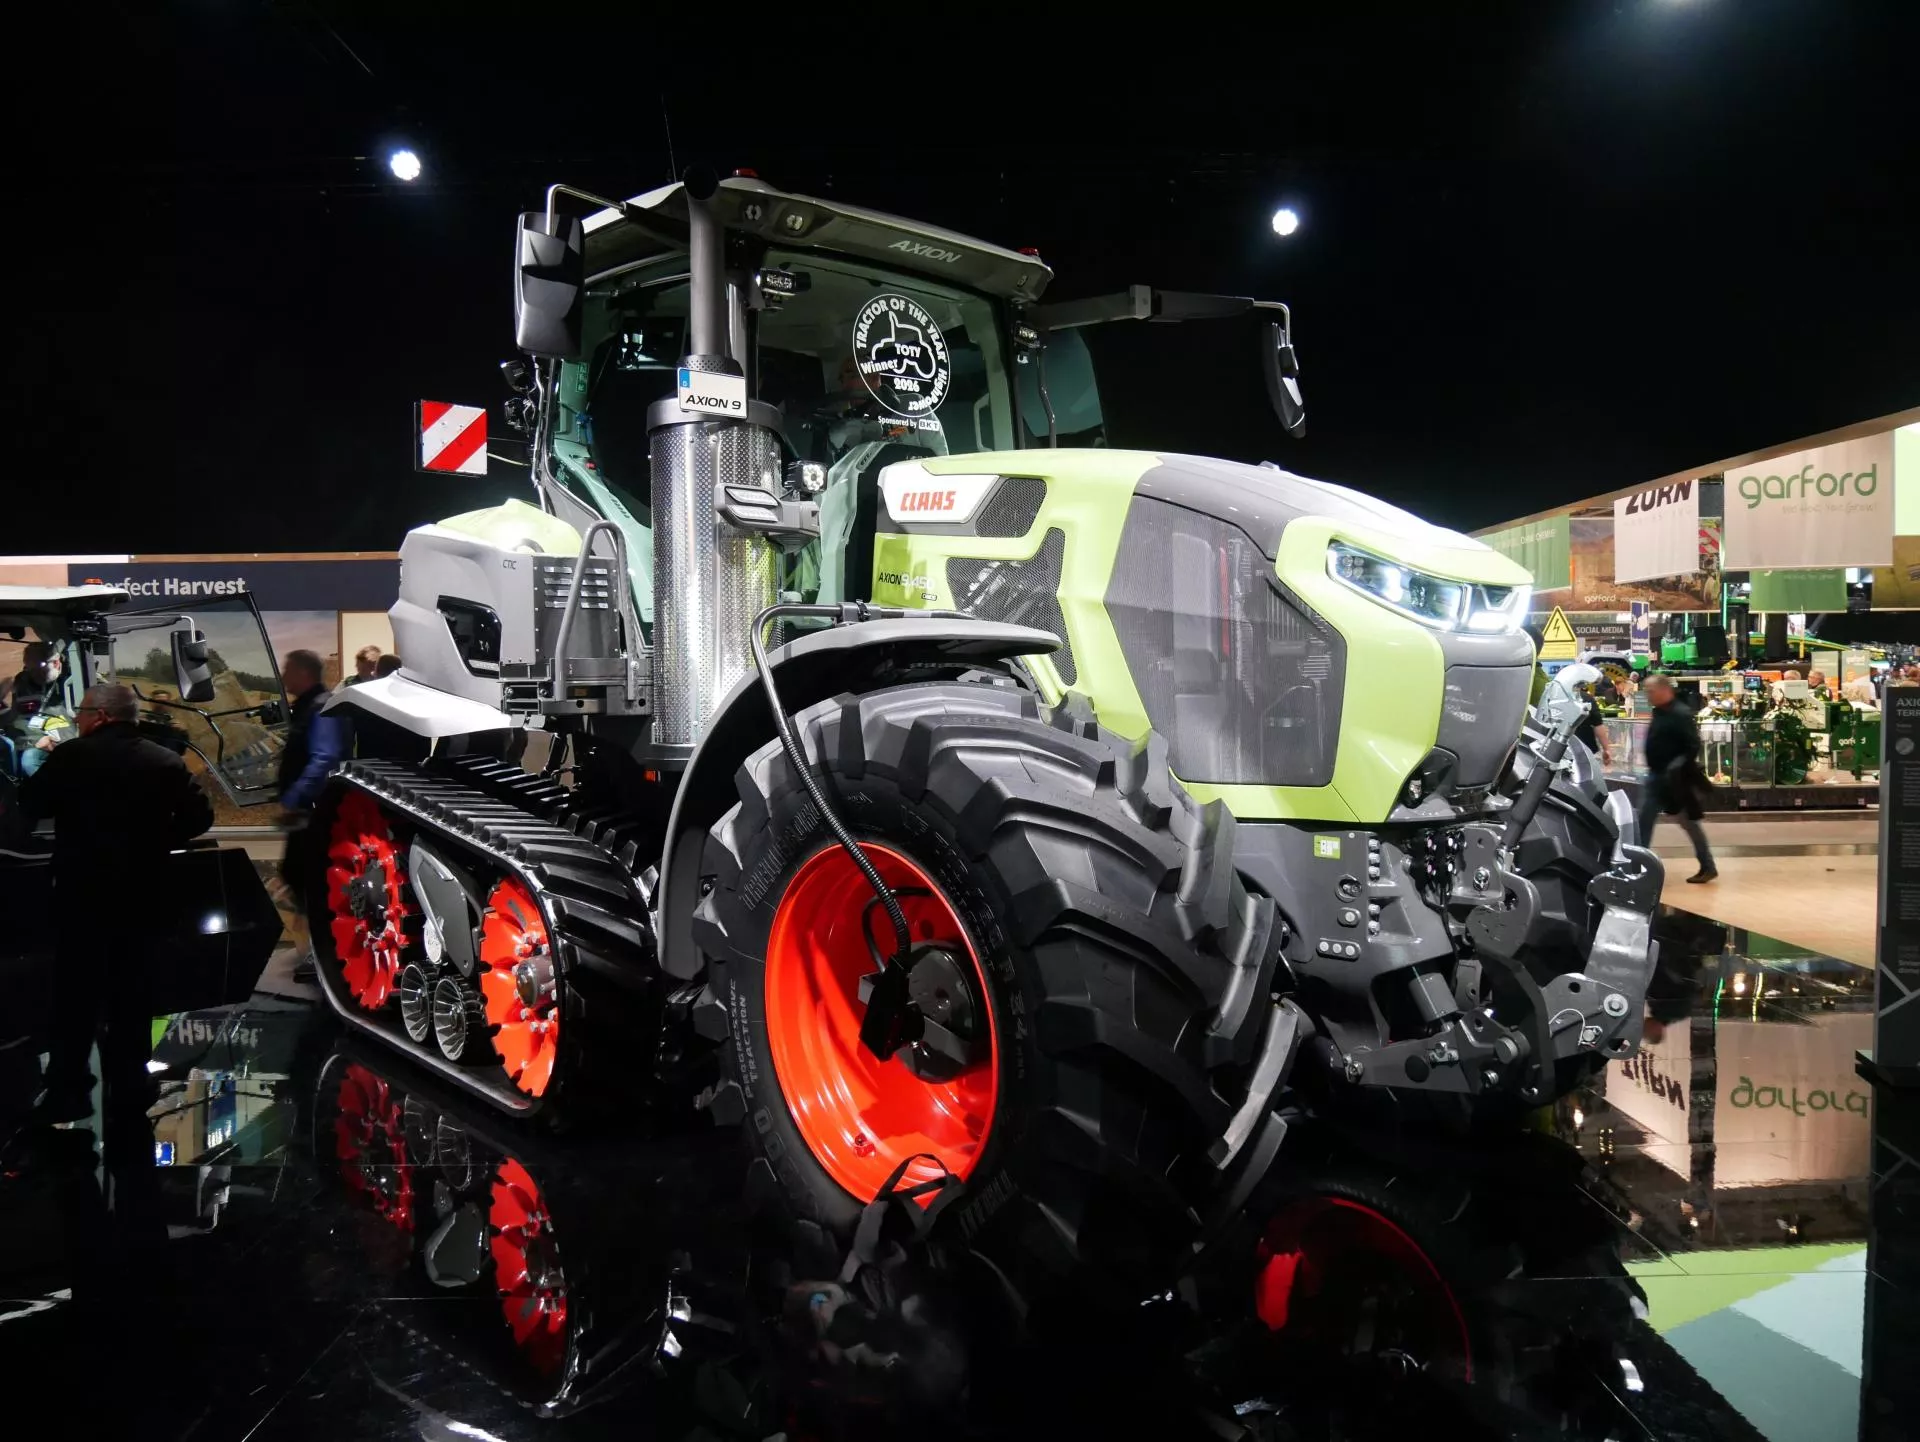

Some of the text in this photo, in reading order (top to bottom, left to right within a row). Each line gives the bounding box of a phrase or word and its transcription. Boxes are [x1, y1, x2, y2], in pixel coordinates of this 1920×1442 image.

[888, 240, 962, 263] AXION
[856, 298, 948, 363] TRACTOR OF THE YEAR
[895, 343, 921, 358] TOTY
[860, 359, 898, 374] Winner
[893, 378, 920, 393] 2026
[685, 394, 742, 410] AXION 9
[878, 416, 940, 431] Sponsored by BKT
[1738, 463, 1877, 510] garford
[900, 490, 957, 511] CLAAS
[879, 572, 902, 586] AXION
[1584, 594, 1616, 604] garford
[1576, 626, 1624, 634] SOCIAL MEDIA
[739, 993, 760, 1083] TRACTION
